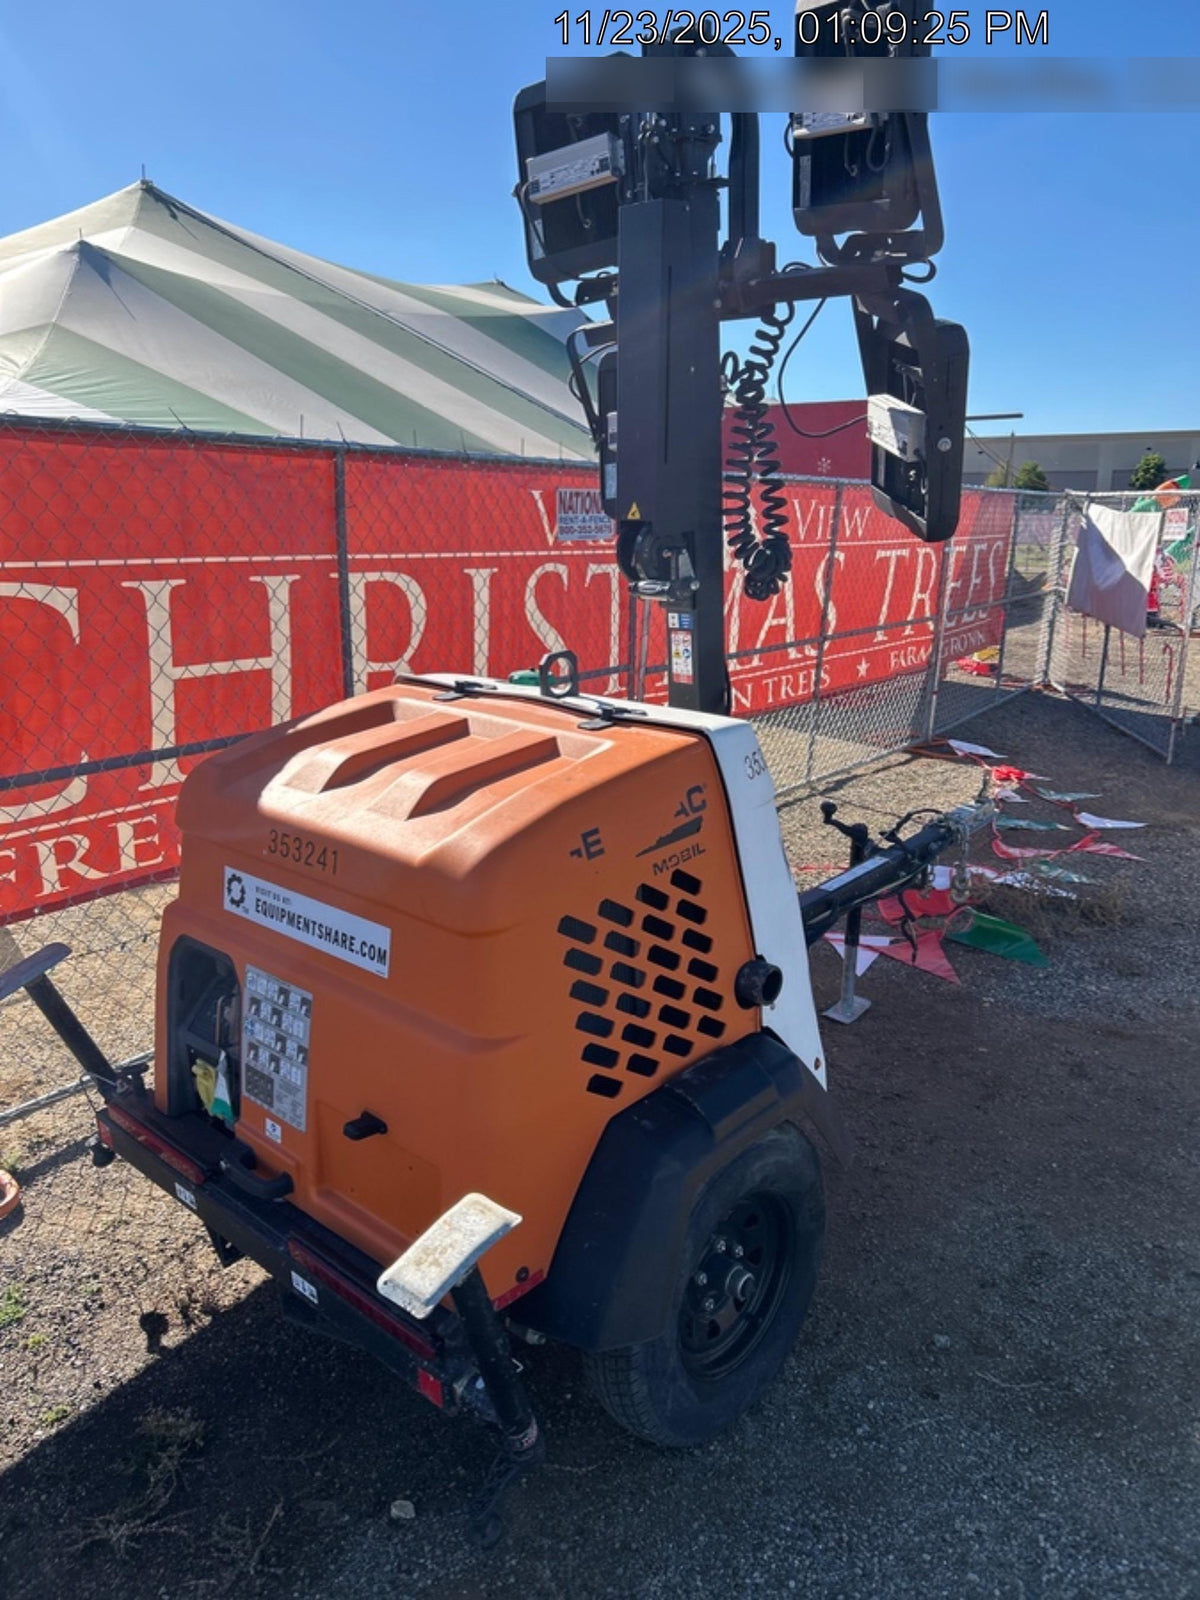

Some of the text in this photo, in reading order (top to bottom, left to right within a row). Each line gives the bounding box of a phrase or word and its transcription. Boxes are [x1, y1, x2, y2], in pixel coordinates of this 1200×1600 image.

[559, 490, 604, 514] NATION
[874, 540, 1004, 642] TREES
[268, 829, 338, 875] 353241
[254, 899, 387, 966] EQUIPMENTSHARE.COM
